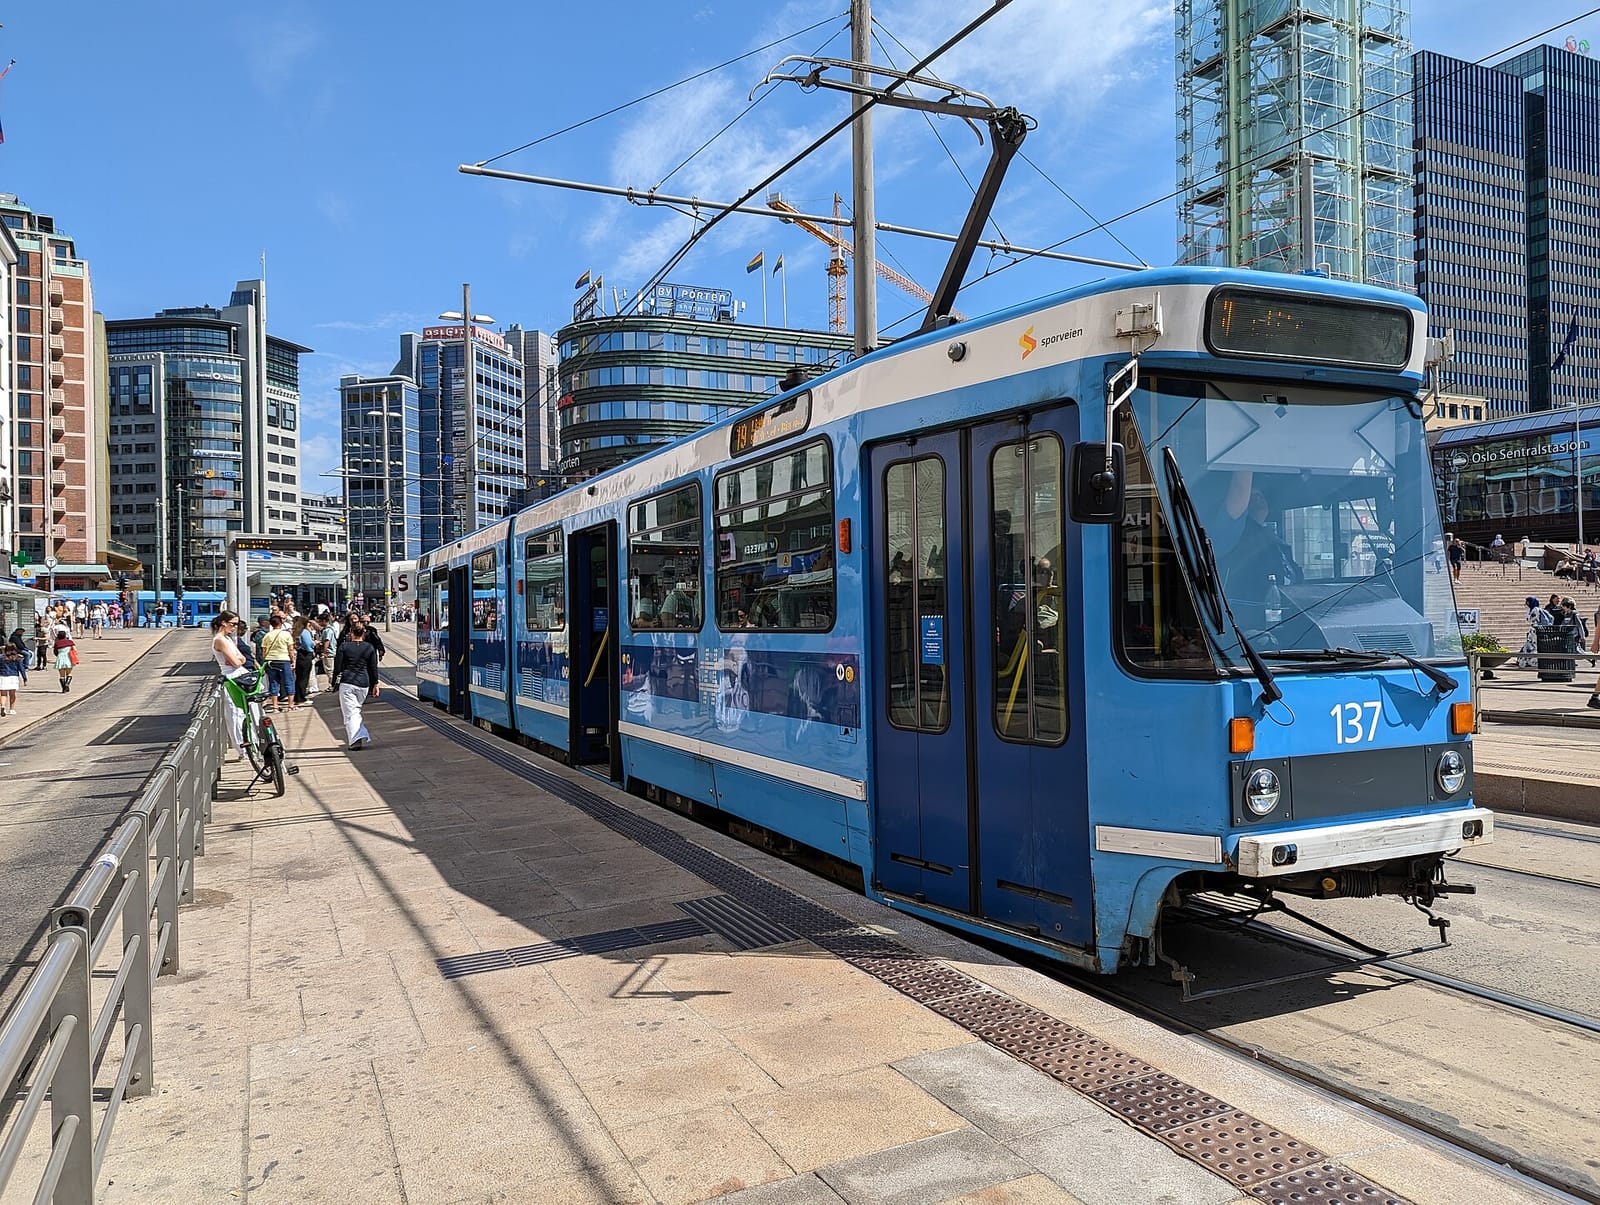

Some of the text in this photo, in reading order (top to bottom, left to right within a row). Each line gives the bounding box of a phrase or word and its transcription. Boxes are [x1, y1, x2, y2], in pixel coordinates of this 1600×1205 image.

[658, 287, 672, 297] BY
[1041, 328, 1083, 348] sporveien
[736, 423, 747, 451] 19
[1472, 440, 1587, 463] Oslo Sentralstasjon
[1329, 701, 1382, 745] 137
